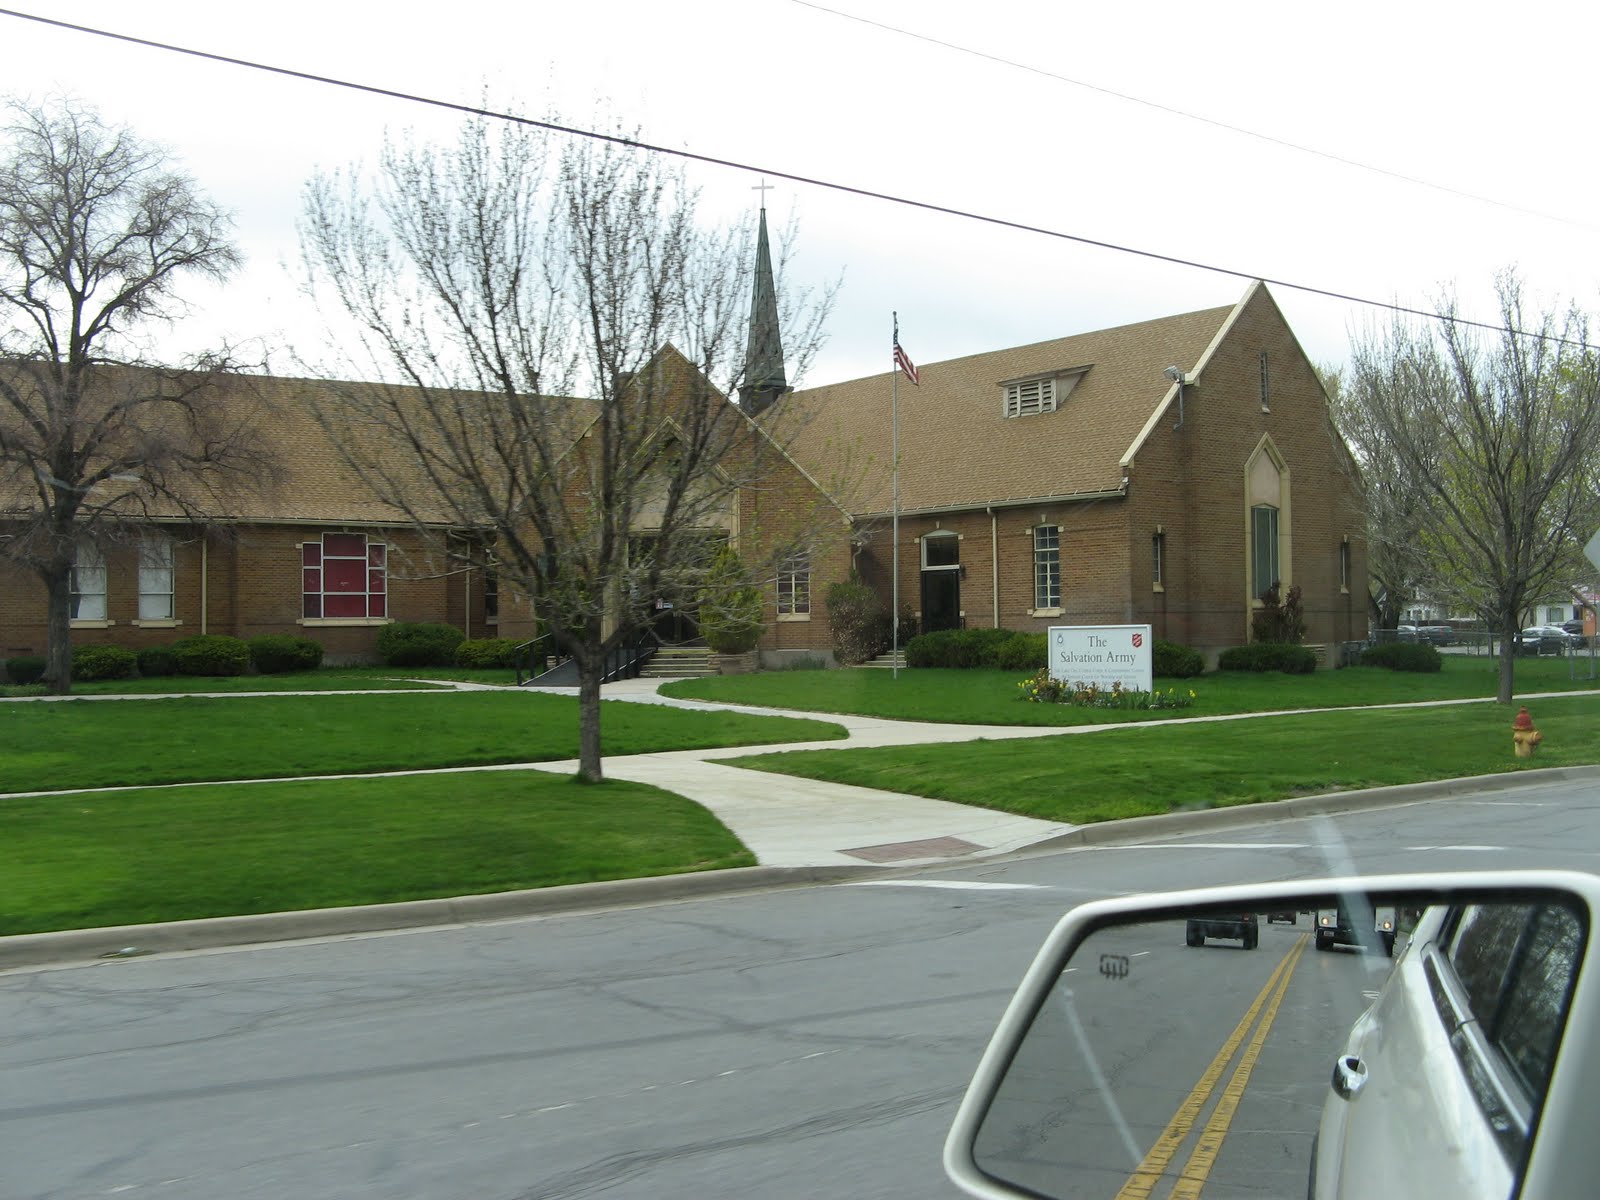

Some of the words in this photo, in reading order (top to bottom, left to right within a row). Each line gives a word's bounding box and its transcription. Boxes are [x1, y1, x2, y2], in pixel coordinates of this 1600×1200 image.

[1088, 635, 1108, 647] The
[1060, 651, 1102, 663] Salvation
[1106, 651, 1136, 666] Army
